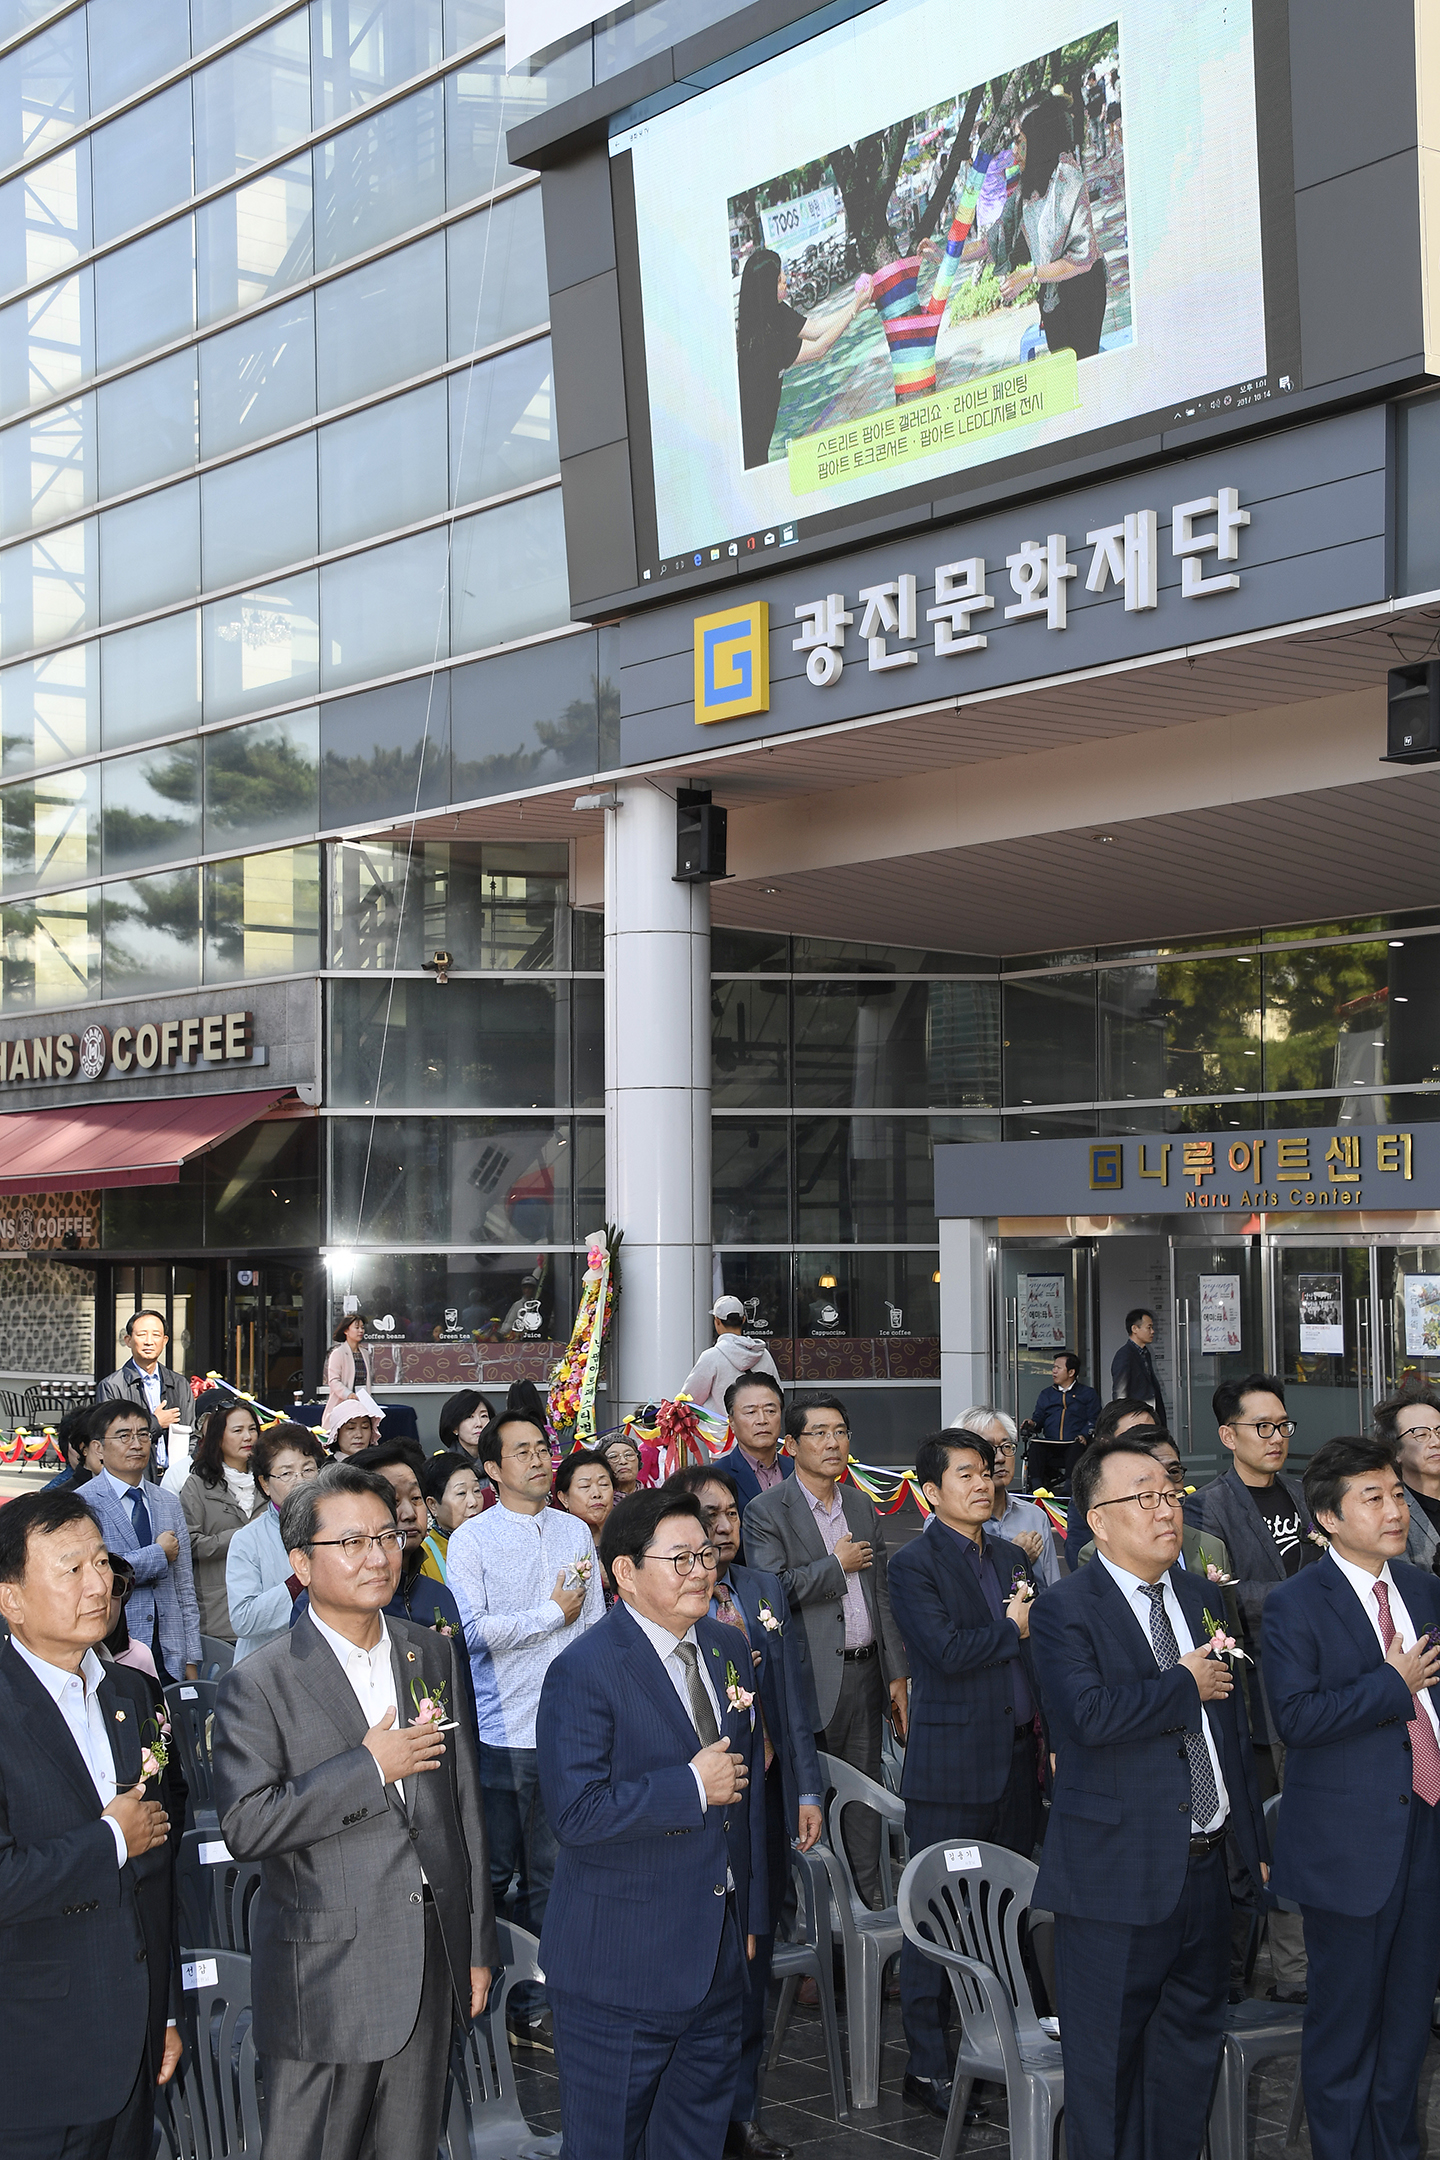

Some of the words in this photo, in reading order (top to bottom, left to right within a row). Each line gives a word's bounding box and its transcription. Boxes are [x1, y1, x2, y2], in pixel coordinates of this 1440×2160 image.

[768, 208, 799, 238] ETOOS
[817, 431, 859, 459] 스트리트
[863, 419, 896, 444] 팝아트
[899, 404, 942, 432] 갤러리쇼
[954, 387, 989, 413] 라이브
[992, 374, 1028, 402] 페인팅
[818, 455, 850, 480] 팝아트
[853, 437, 909, 468] 토크콘서트
[920, 421, 955, 448] 팝아트
[958, 401, 1017, 435] LED디지털
[1020, 392, 1044, 416] 전시
[792, 487, 1251, 687] 광진문화재단
[112, 1012, 248, 1072] COFFEE
[1138, 1133, 1413, 1187] 나루아트센터
[1185, 1191, 1230, 1208] Naru
[1240, 1190, 1279, 1207] Arts
[1289, 1188, 1362, 1205] Center
[37, 1216, 92, 1239] COFFEE
[811, 1329, 846, 1337] Cappuccino
